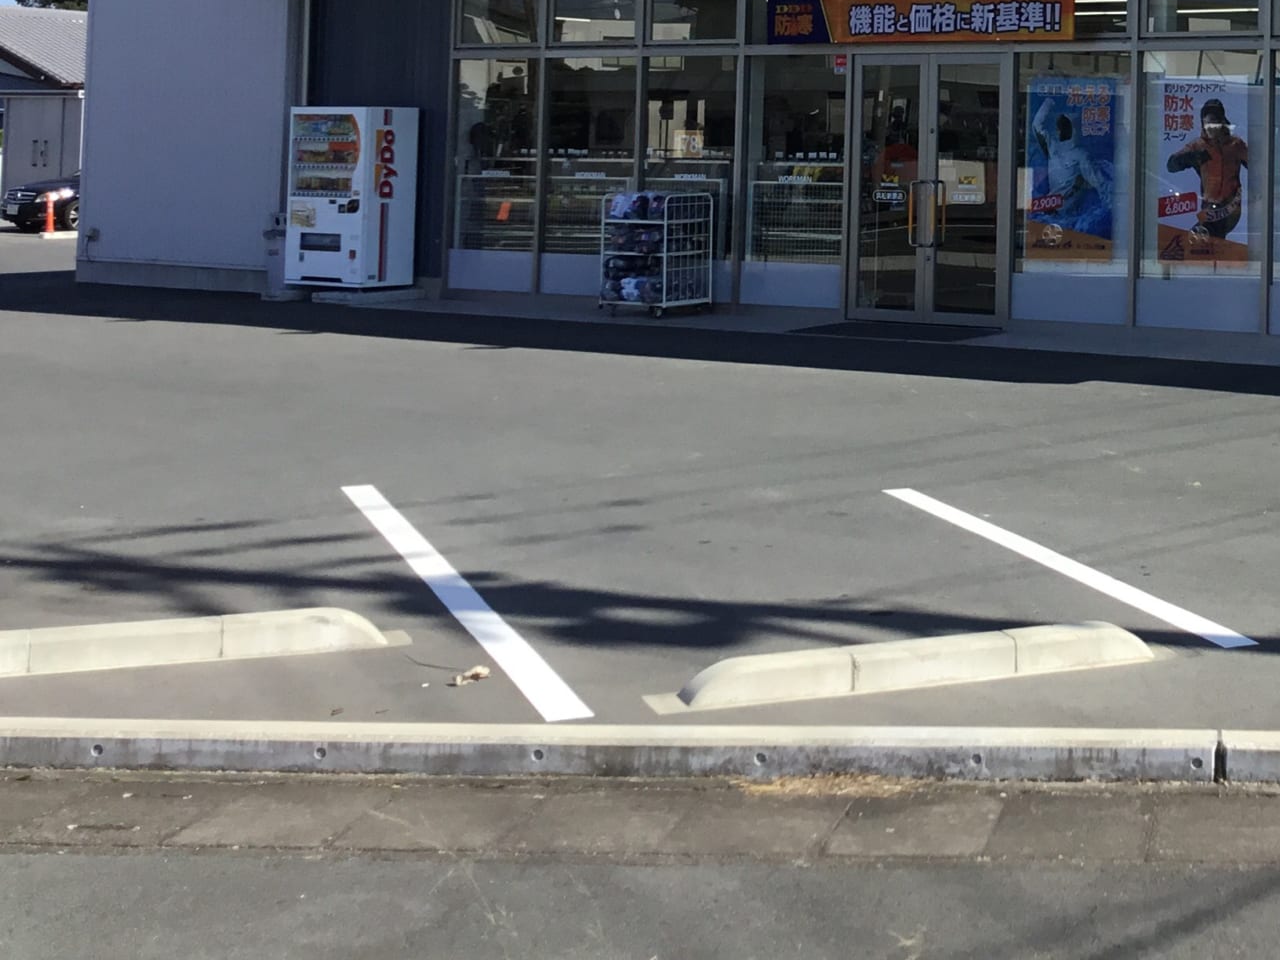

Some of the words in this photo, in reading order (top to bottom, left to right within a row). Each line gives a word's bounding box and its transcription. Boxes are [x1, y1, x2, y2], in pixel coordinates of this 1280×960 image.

[1164, 95, 1195, 112] 防水
[1164, 113, 1195, 131] 防寒
[1163, 132, 1187, 141] スーツ
[379, 129, 399, 199] DyDo
